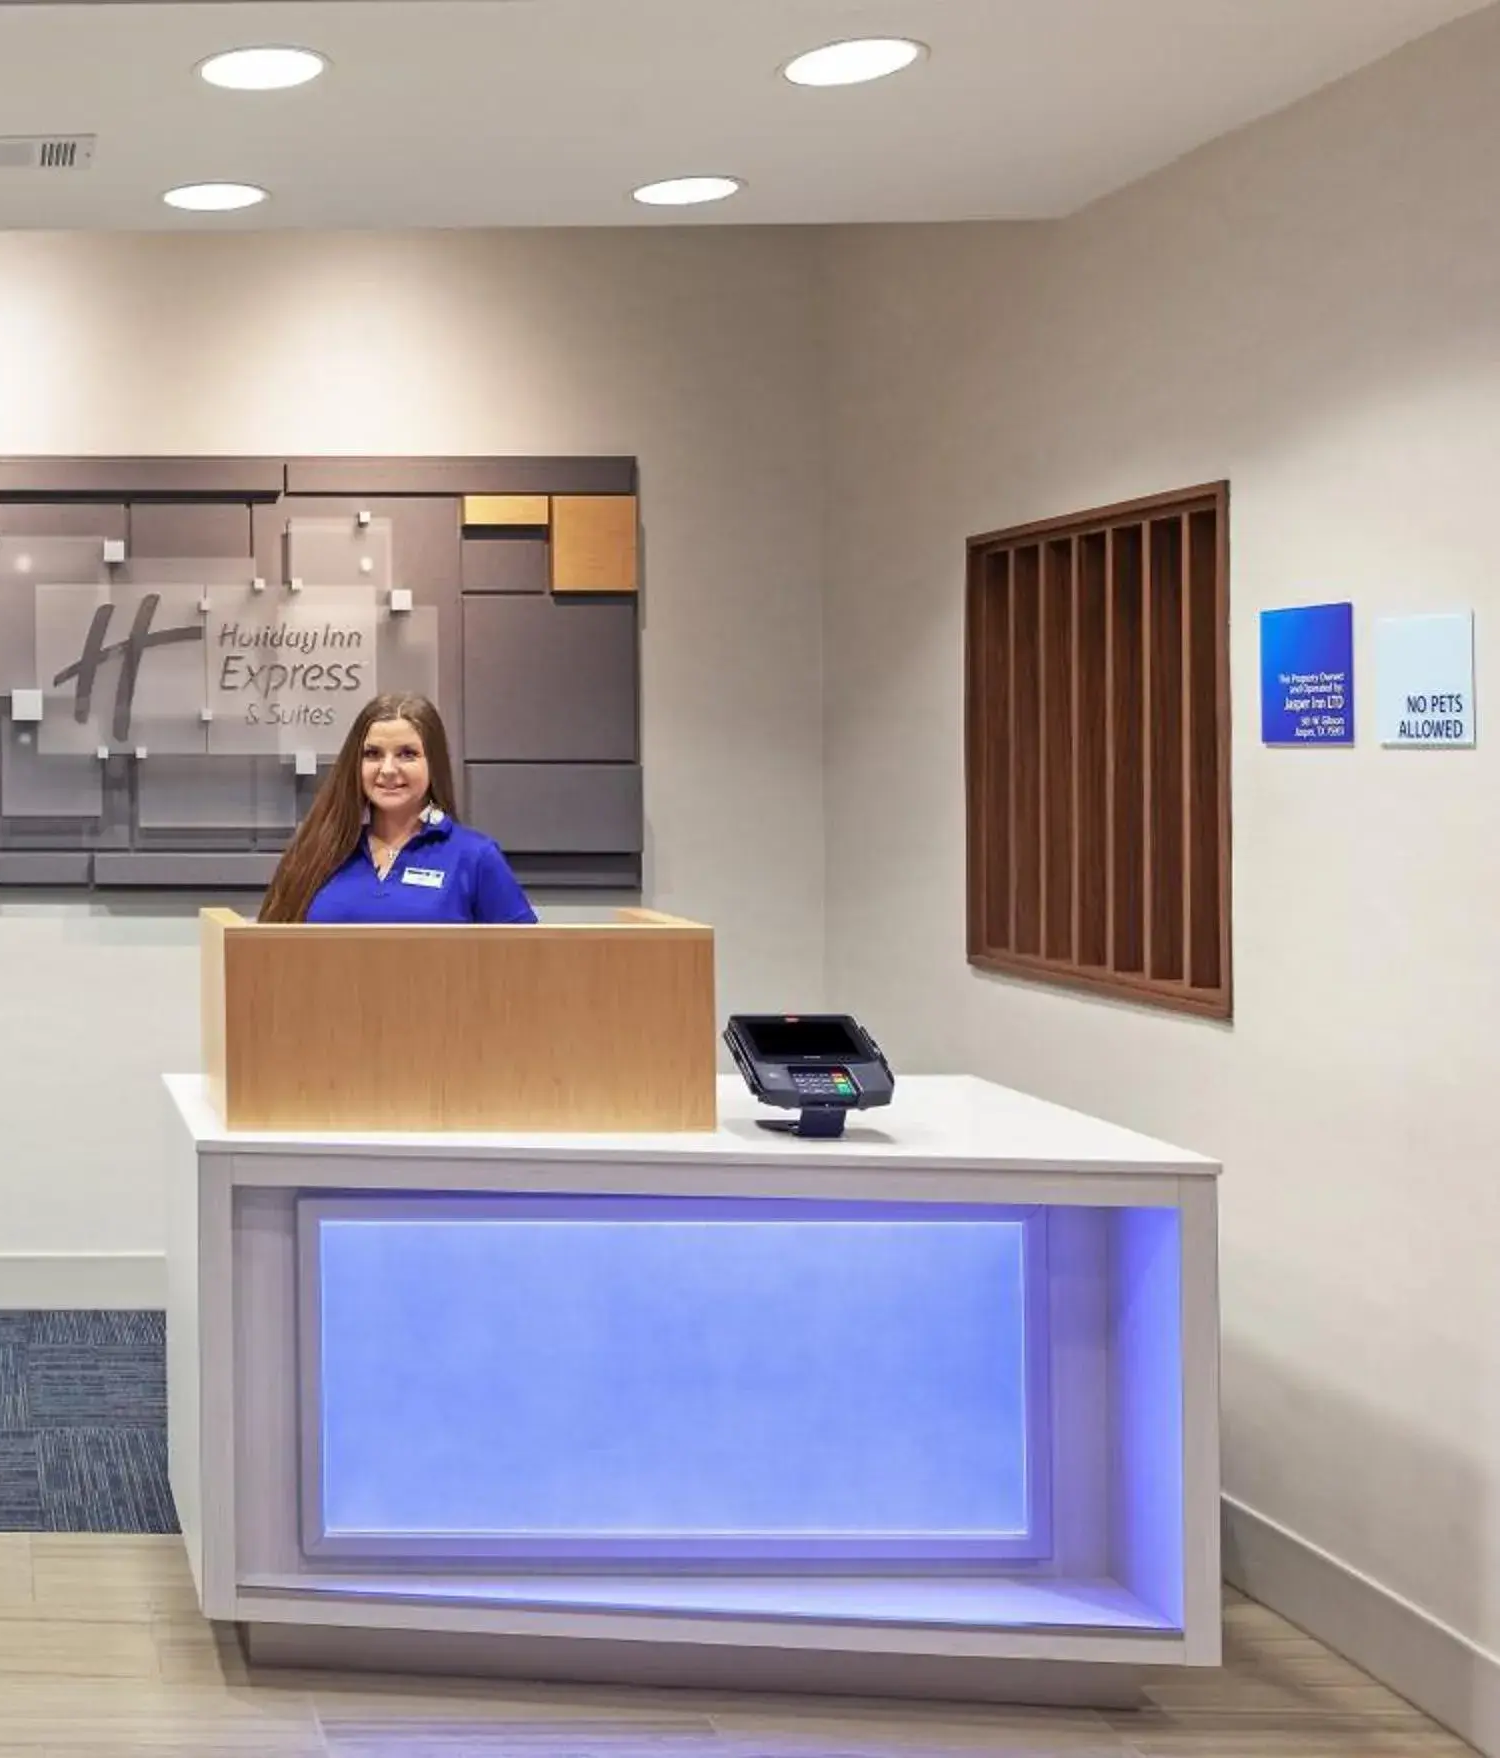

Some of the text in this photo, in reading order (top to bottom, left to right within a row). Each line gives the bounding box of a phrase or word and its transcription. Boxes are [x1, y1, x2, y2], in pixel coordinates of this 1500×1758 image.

[218, 623, 363, 654] Holiday Inn
[219, 655, 363, 699] Express
[1284, 695, 1310, 711] Jasper
[1311, 695, 1326, 708] Inn
[1407, 693, 1463, 713] NO PETS
[244, 703, 337, 727] & Suites
[1398, 719, 1463, 738] ALLOWED
